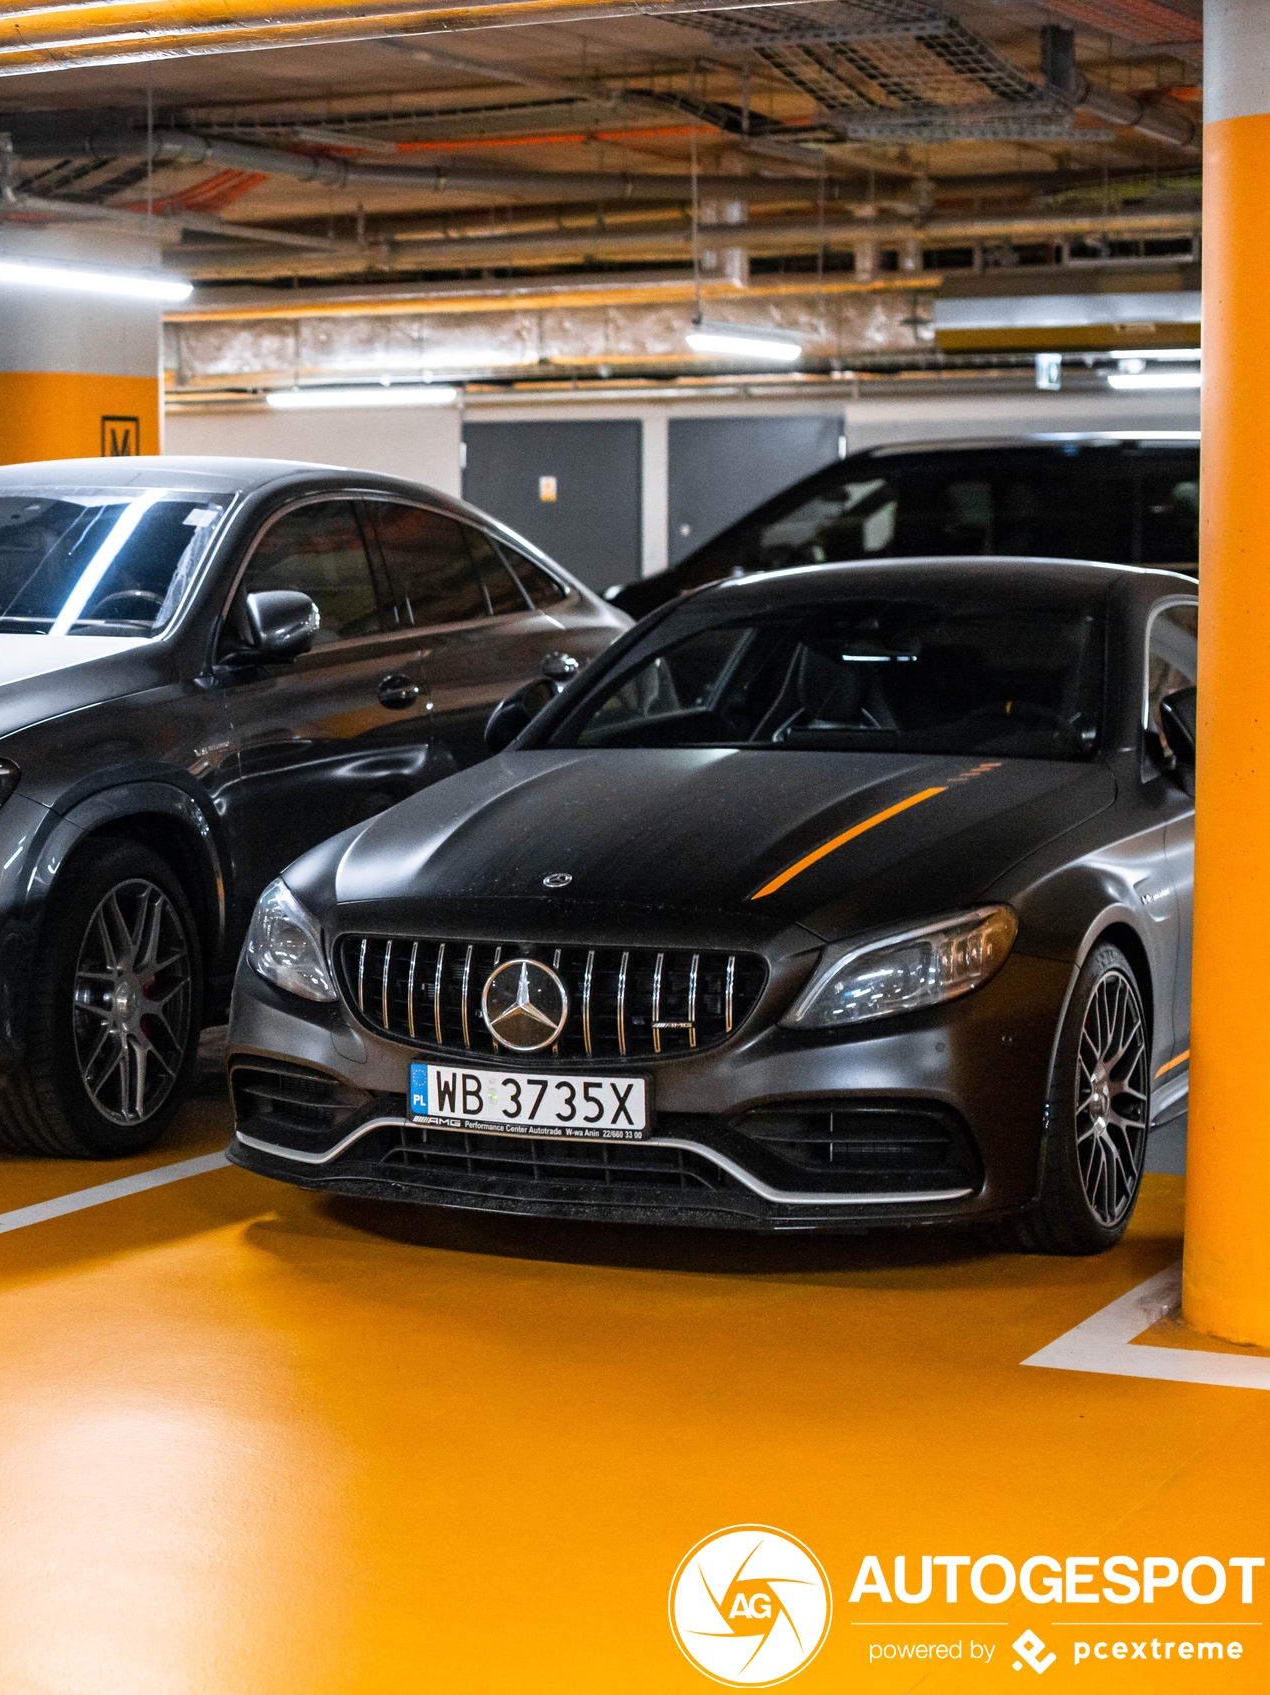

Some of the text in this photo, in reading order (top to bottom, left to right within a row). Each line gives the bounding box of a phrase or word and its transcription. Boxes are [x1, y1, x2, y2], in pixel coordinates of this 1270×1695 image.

[413, 1094, 427, 1107] PL
[436, 1070, 635, 1126] WB 3735X
[425, 1117, 643, 1140] AMG Performance Center Autotrade W-wa Anin 22/660 33 00
